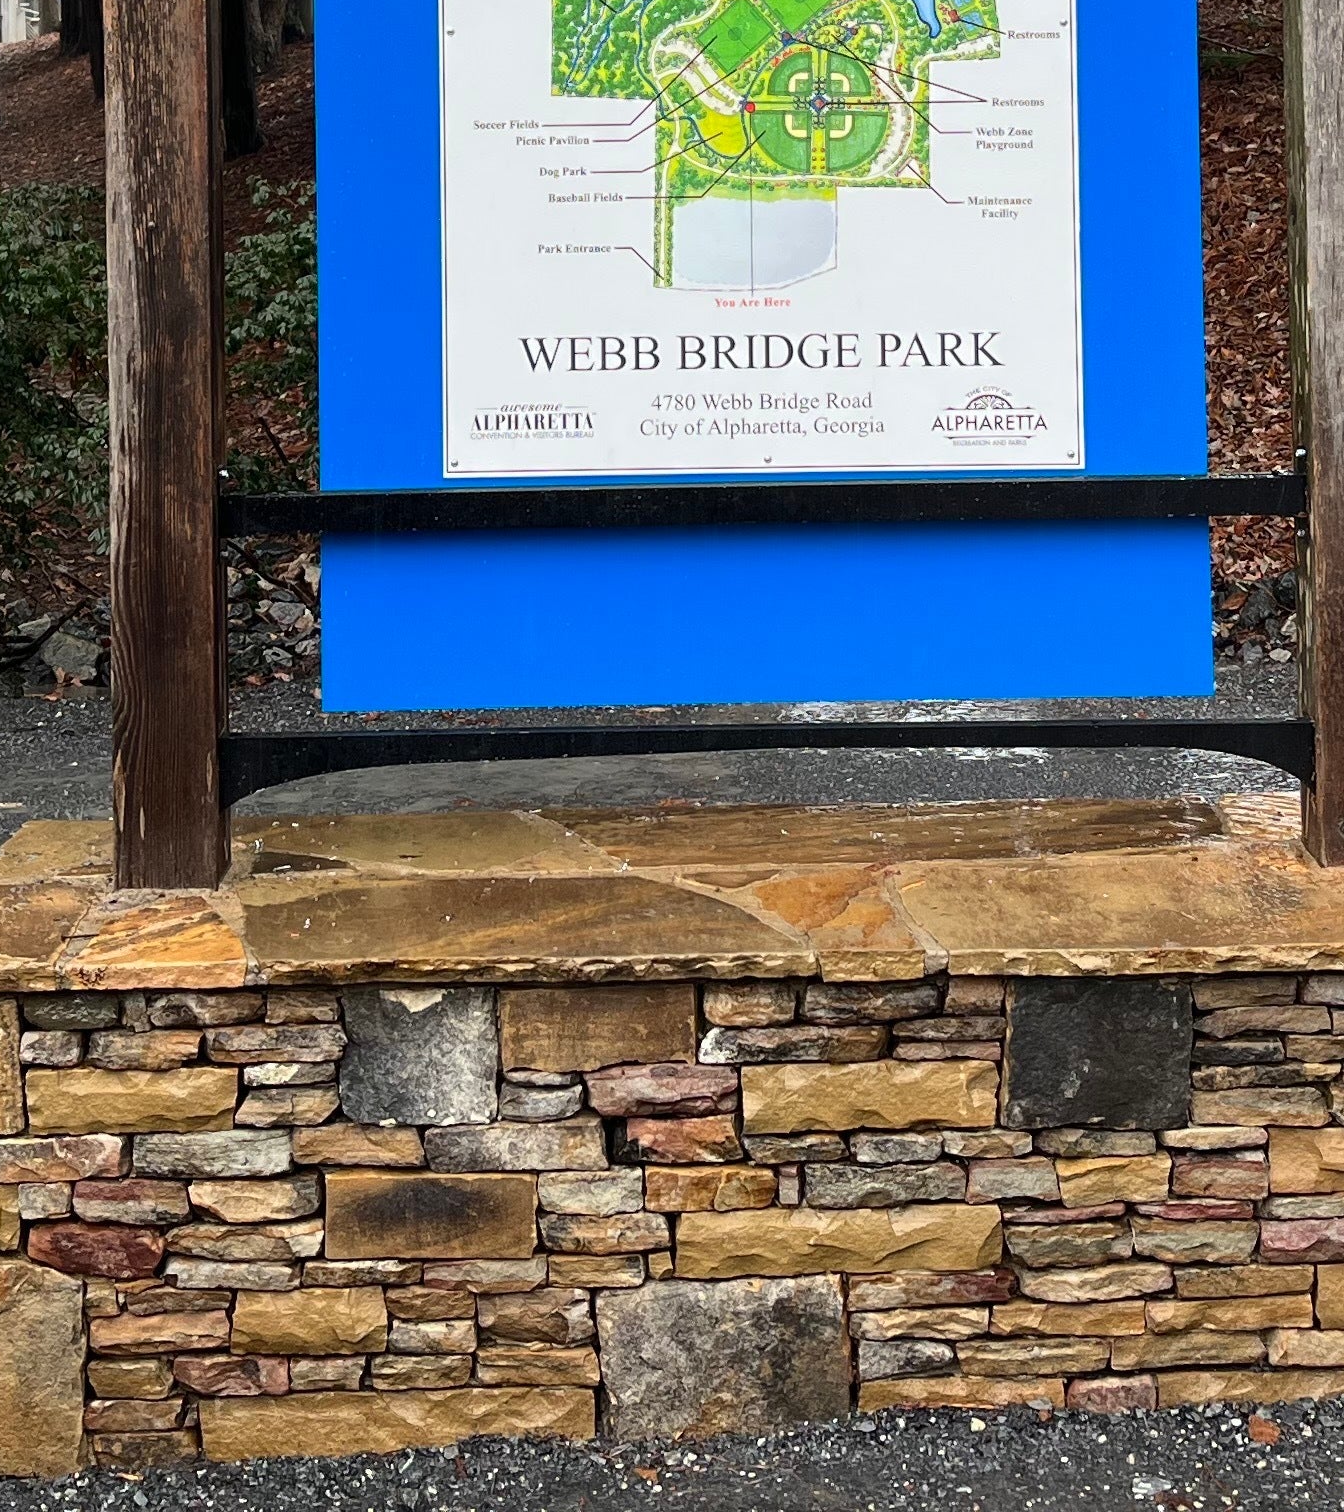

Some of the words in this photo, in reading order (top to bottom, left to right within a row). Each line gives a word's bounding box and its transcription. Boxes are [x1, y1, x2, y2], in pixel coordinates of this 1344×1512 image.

[1007, 29, 1061, 40] Restrooms
[991, 96, 1045, 107] Restrooms
[473, 119, 507, 130] Soccer
[509, 119, 540, 130] Fields
[975, 126, 1006, 137] Webb
[1007, 126, 1034, 137] Zone
[515, 135, 547, 146] Picnic
[549, 135, 590, 146] Pavilion
[975, 139, 1034, 152] Playground
[539, 166, 560, 180] Dog
[562, 166, 587, 177] Park
[548, 193, 591, 203] Baseball
[593, 192, 624, 203] Fields
[967, 195, 1033, 207] Maintenance
[981, 208, 1019, 222] Facility
[537, 244, 563, 254] Park
[565, 243, 612, 254] Entrance
[714, 297, 736, 308] You
[739, 296, 760, 308] Are
[763, 296, 791, 308] Here
[519, 336, 660, 373] WEBB
[677, 333, 862, 370] BRIDGE
[877, 332, 1006, 368] PARK
[650, 393, 696, 411] 4780
[701, 393, 753, 411] Webb
[759, 392, 820, 414] Bridge
[826, 391, 873, 409] Road
[470, 413, 594, 431] ALPHARETTA
[639, 418, 678, 441] City
[684, 417, 705, 436] of
[708, 416, 808, 439] Alpharetta,
[813, 415, 885, 438] Georgia
[931, 414, 1048, 432] ALPHARETTA
